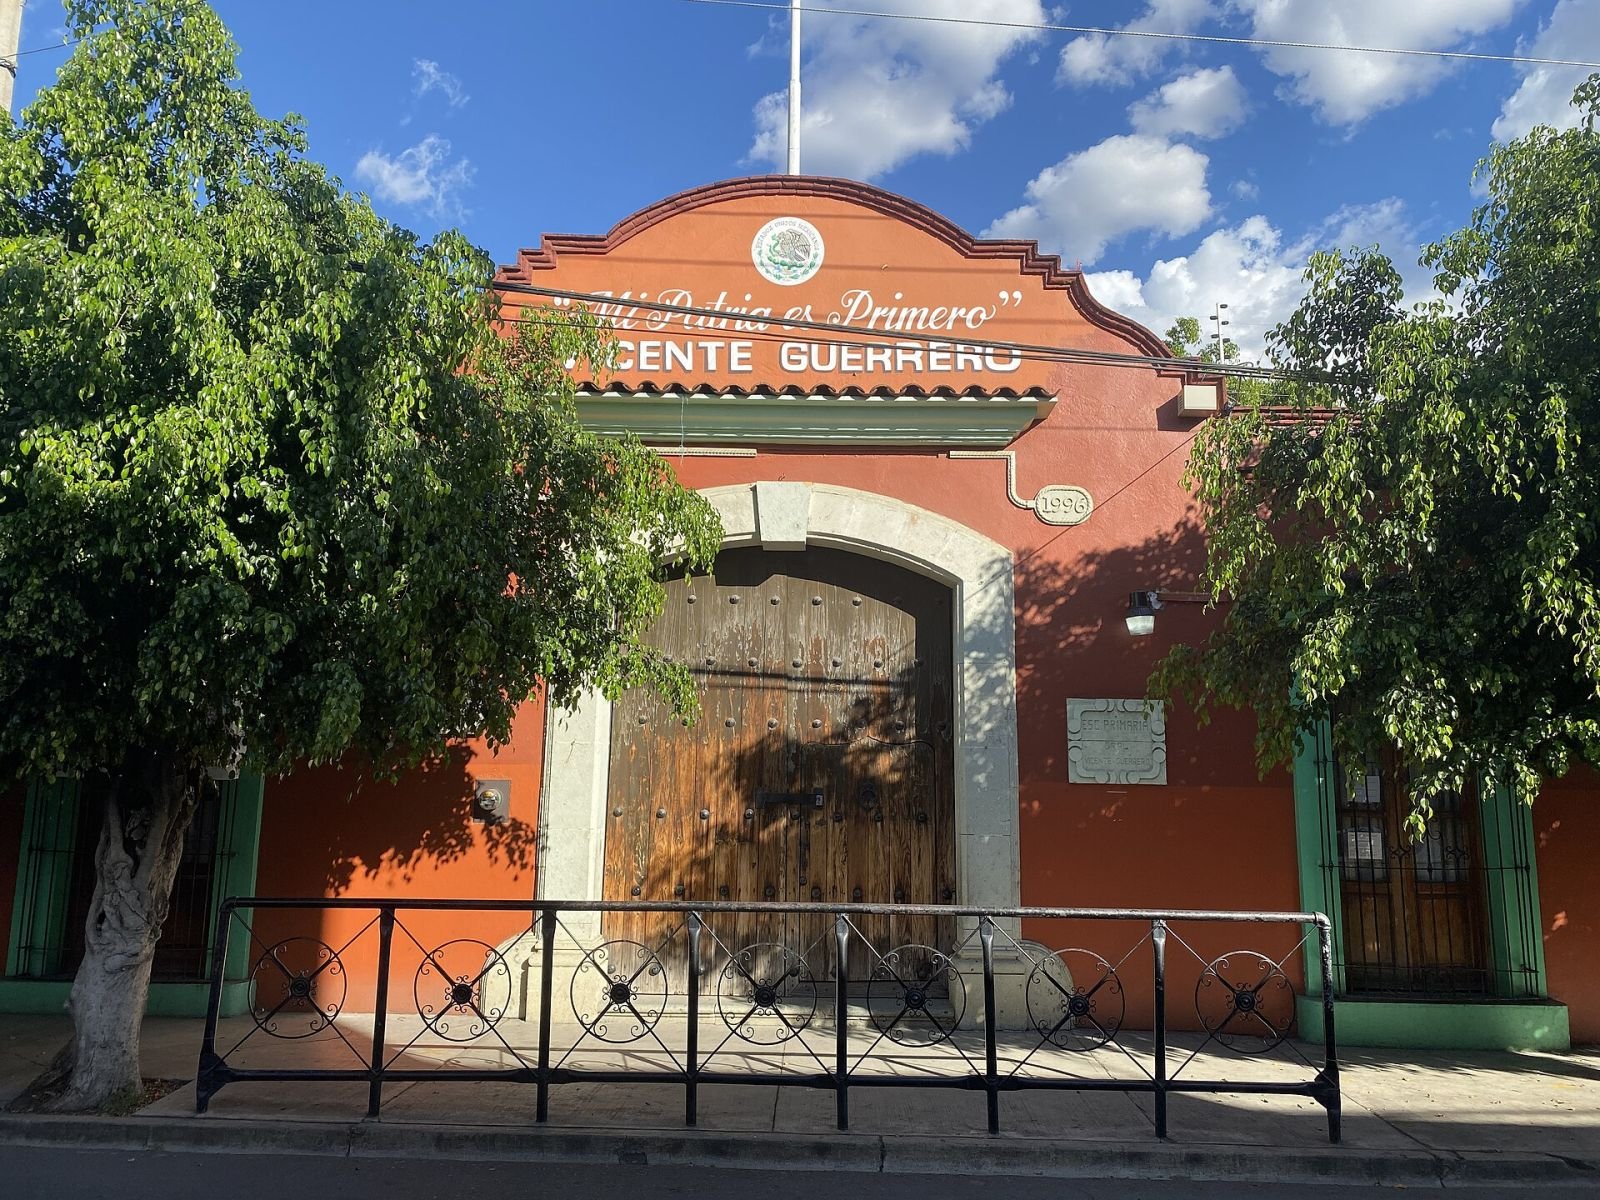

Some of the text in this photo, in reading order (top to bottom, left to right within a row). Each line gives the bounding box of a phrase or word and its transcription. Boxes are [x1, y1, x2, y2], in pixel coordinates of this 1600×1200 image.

[645, 288, 772, 331] Patria
[783, 304, 815, 331] es
[779, 341, 1022, 373] GUERRERO
[1042, 496, 1085, 514] 1996
[1103, 719, 1149, 732] PRIMARIA
